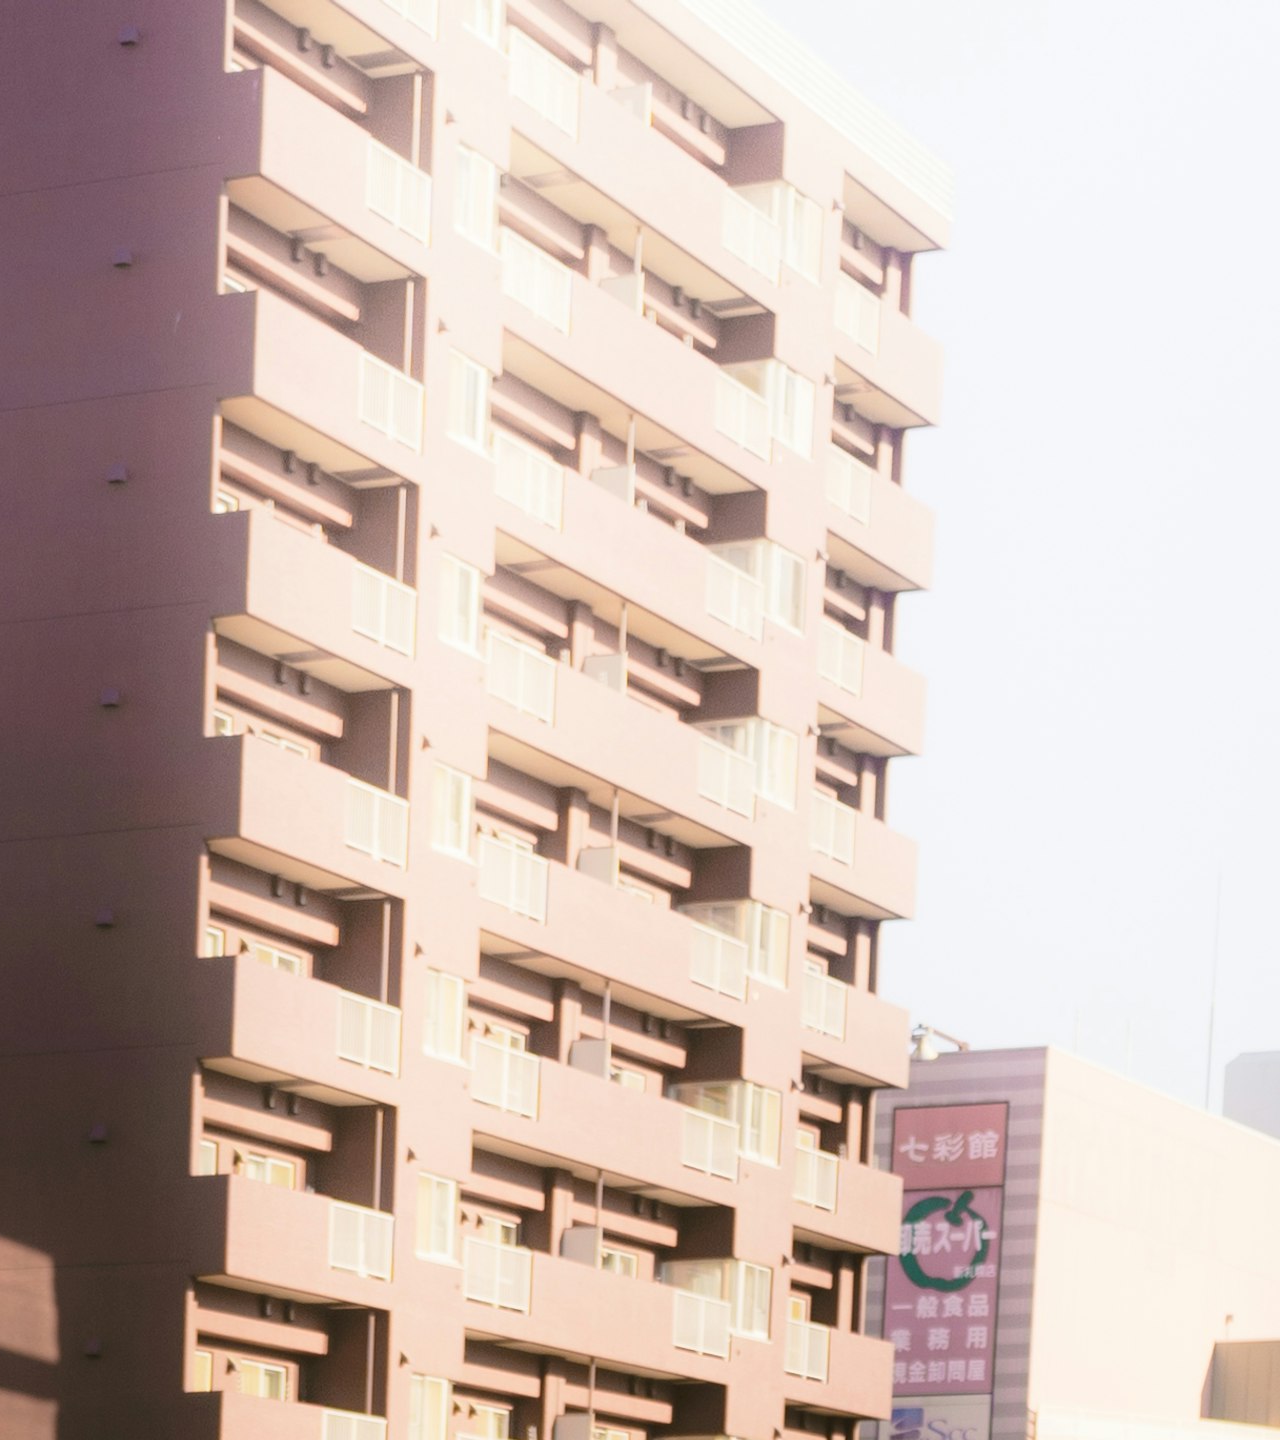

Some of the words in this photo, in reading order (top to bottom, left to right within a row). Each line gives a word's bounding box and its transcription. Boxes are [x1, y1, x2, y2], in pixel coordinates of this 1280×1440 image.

[899, 1130, 999, 1162] 七彩館
[891, 1294, 989, 1318] 一般食品
